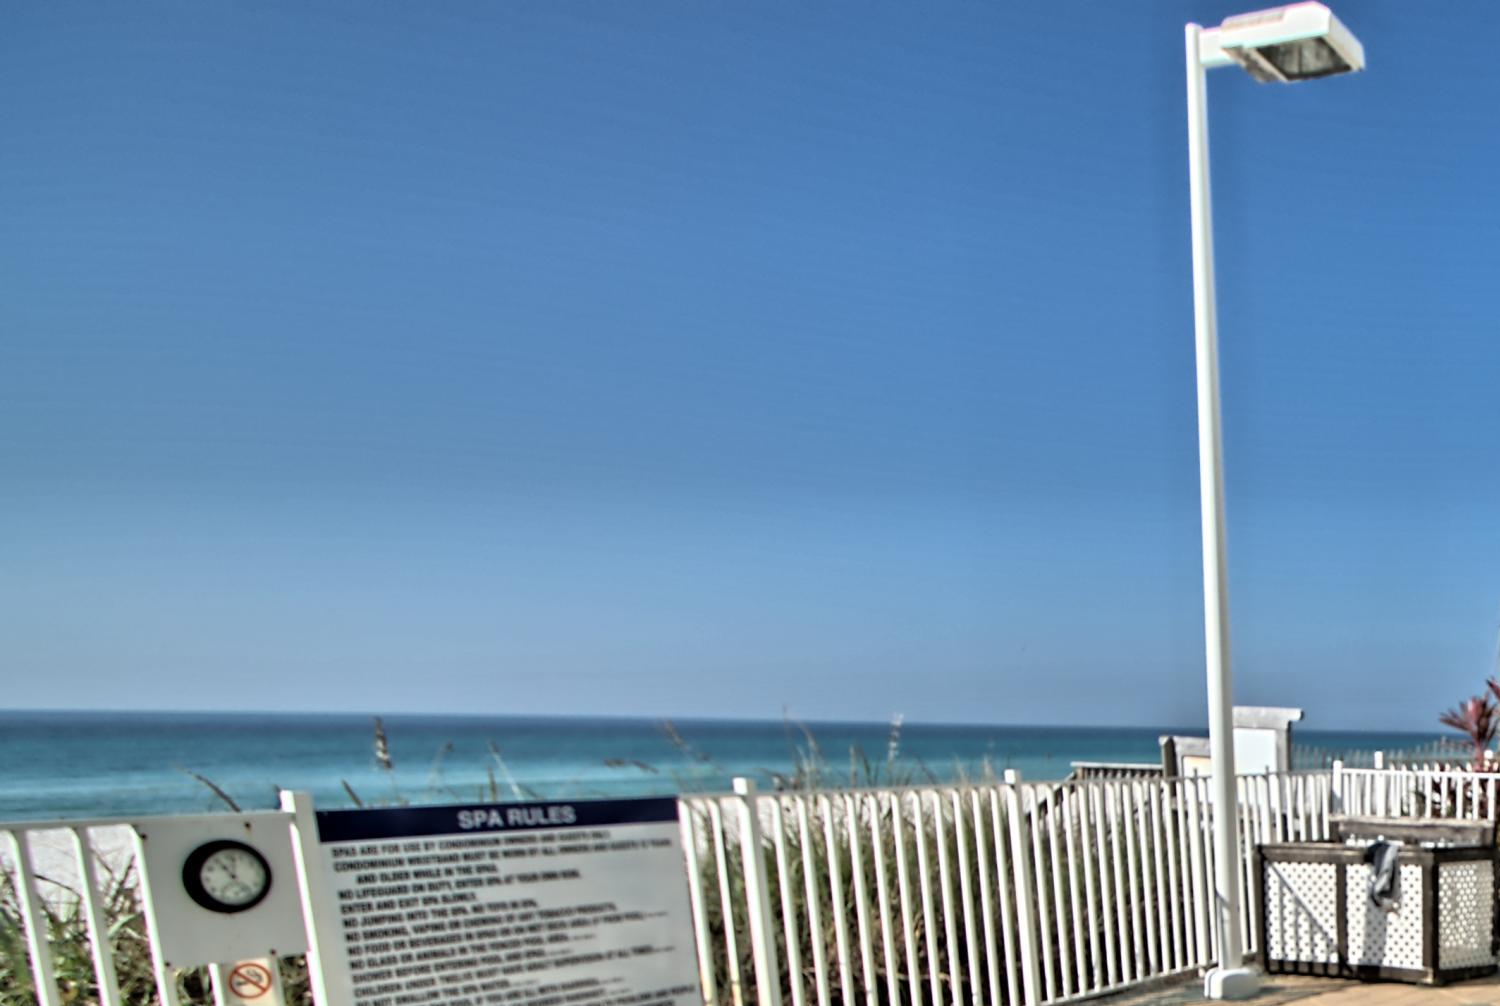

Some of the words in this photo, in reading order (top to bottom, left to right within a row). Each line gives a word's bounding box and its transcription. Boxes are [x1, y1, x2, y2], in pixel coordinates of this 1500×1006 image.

[457, 809, 505, 829] SPA
[508, 805, 576, 825] RULES
[356, 872, 376, 884] AND
[338, 888, 353, 899] NO
[340, 900, 373, 914] ENTER
[342, 916, 358, 928] NO
[345, 930, 360, 941] NO
[348, 944, 362, 955] NO
[350, 958, 364, 970] NO
